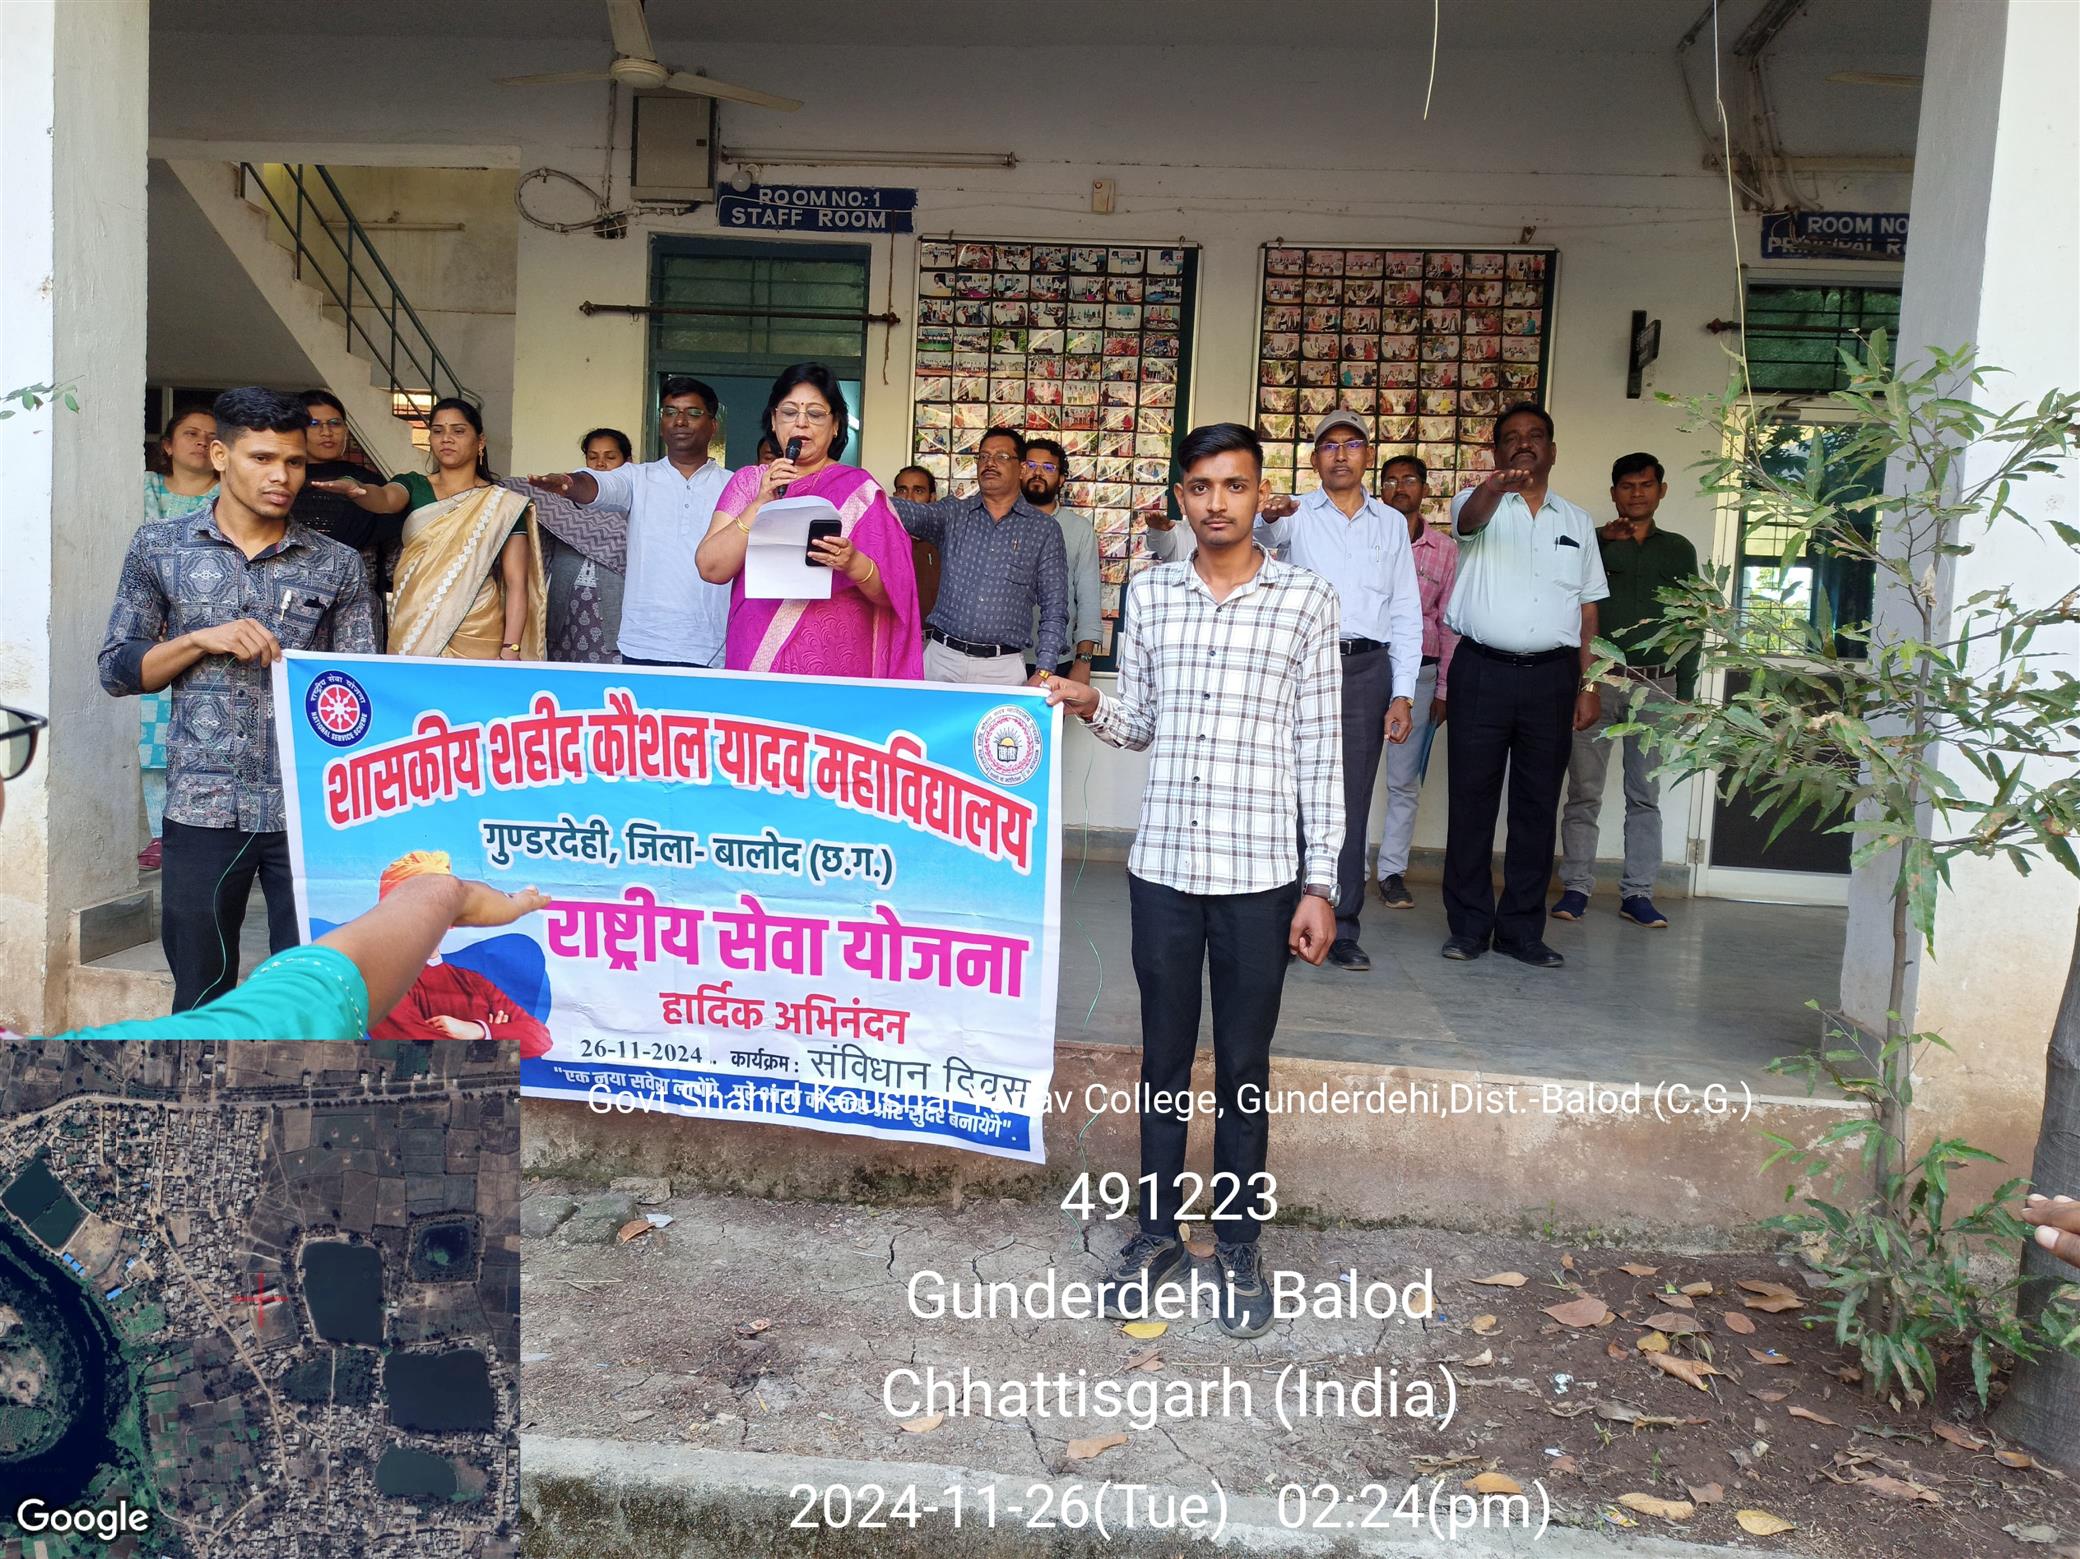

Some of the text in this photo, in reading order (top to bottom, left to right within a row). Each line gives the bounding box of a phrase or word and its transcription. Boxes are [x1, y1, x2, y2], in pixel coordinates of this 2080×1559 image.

[731, 207, 886, 229] STAFF ROOM
[1808, 216, 1872, 234] ROOM
[310, 711, 368, 742] NATIONAL SERVICE SCHEME
[328, 715, 480, 824] शासकीय
[490, 696, 584, 784] शहीद
[589, 693, 710, 779] कौशल
[714, 719, 809, 792] यादव
[814, 735, 1032, 868] महाविद्यालय
[484, 818, 893, 886] गुण्डरदेही, जिला- बालोद (छ.ग.)
[545, 888, 1030, 997] राष्ट्रीय सेवा योजना
[660, 980, 910, 1045] हार्दिक अभिनंदन
[579, 1039, 703, 1064] 26-11-2024
[807, 1043, 932, 1090] संविधान
[592, 1071, 627, 1087] नया
